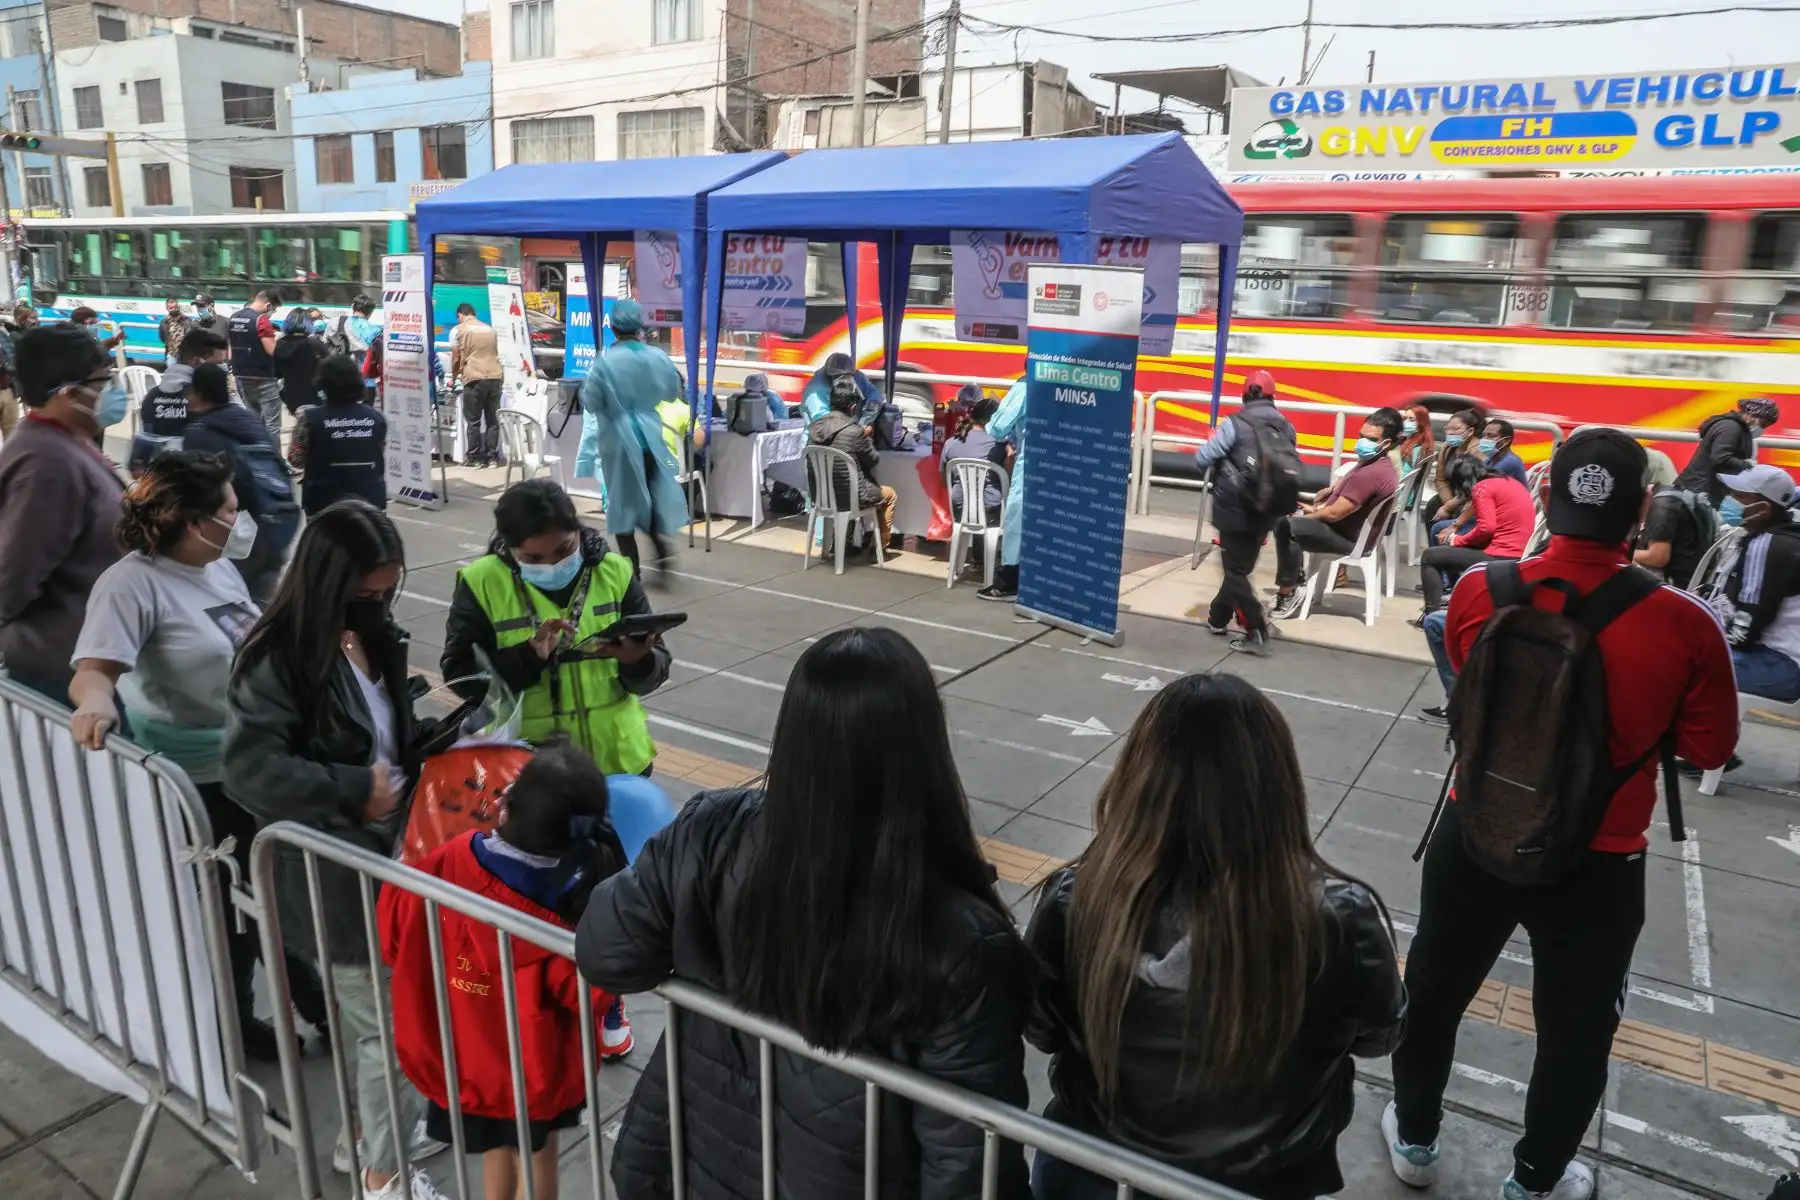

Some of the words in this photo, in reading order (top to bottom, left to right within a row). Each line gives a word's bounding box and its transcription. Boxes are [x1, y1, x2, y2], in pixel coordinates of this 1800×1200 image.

[1269, 89, 1346, 116] GAS
[1359, 82, 1557, 114] NATURAL
[1574, 68, 1800, 106] VEHICUL
[1501, 117, 1553, 137] FH
[1653, 110, 1781, 148] GLP
[1319, 125, 1427, 156] GNV
[1443, 144, 1541, 157] CONVERSIONES
[1545, 144, 1572, 156] GNV
[1577, 143, 1587, 154] &
[1592, 143, 1619, 155] GLP
[1354, 173, 1407, 181] LOVATO
[1003, 232, 1059, 257] Vam
[1119, 236, 1150, 258] tu
[727, 256, 784, 275] entro
[1510, 291, 1549, 312] 1388
[570, 311, 611, 328] MINA
[1053, 354, 1061, 362] de
[1076, 357, 1107, 368] Integradas
[1107, 360, 1116, 368] de
[1116, 361, 1133, 371] Salud
[1036, 362, 1069, 383] Lima
[1072, 368, 1120, 389] Centro
[1055, 387, 1097, 407] MINSA
[154, 404, 187, 419] Salud
[323, 416, 375, 430] Ministerio
[331, 430, 346, 440] de
[346, 429, 373, 439] Salud
